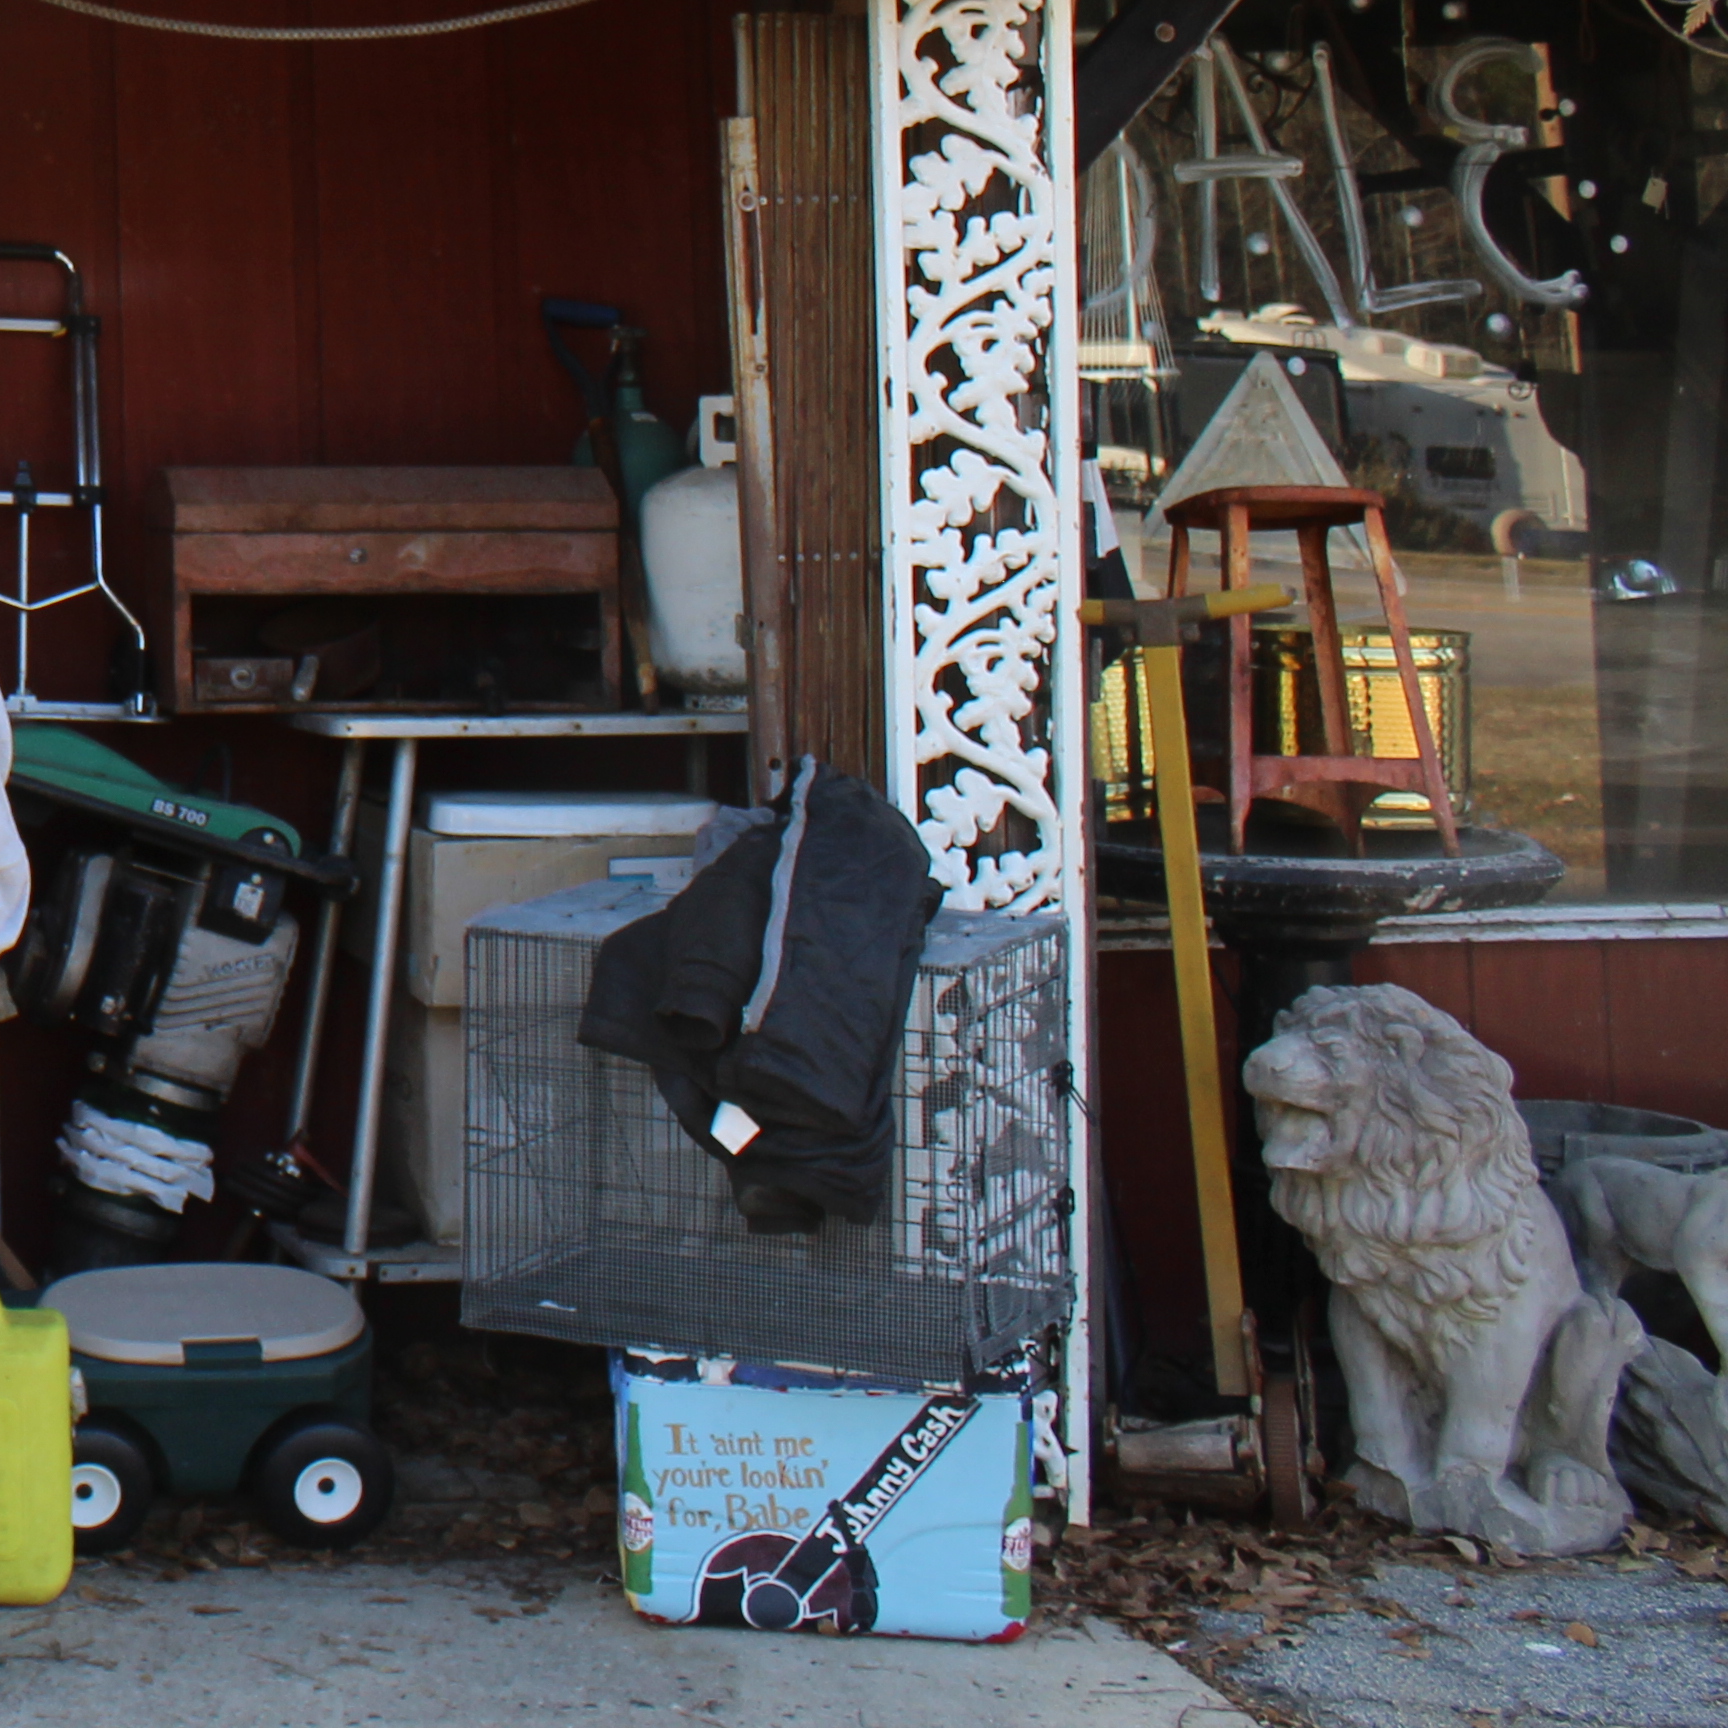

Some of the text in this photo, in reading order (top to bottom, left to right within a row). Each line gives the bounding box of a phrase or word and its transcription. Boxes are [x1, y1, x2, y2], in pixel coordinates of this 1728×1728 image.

[152, 798, 208, 827] BS 700
[663, 1422, 700, 1456] It
[774, 1436, 816, 1458] me
[900, 1400, 966, 1462] Cash
[651, 1458, 830, 1496] you're lookin'
[725, 1493, 812, 1531] Babe
